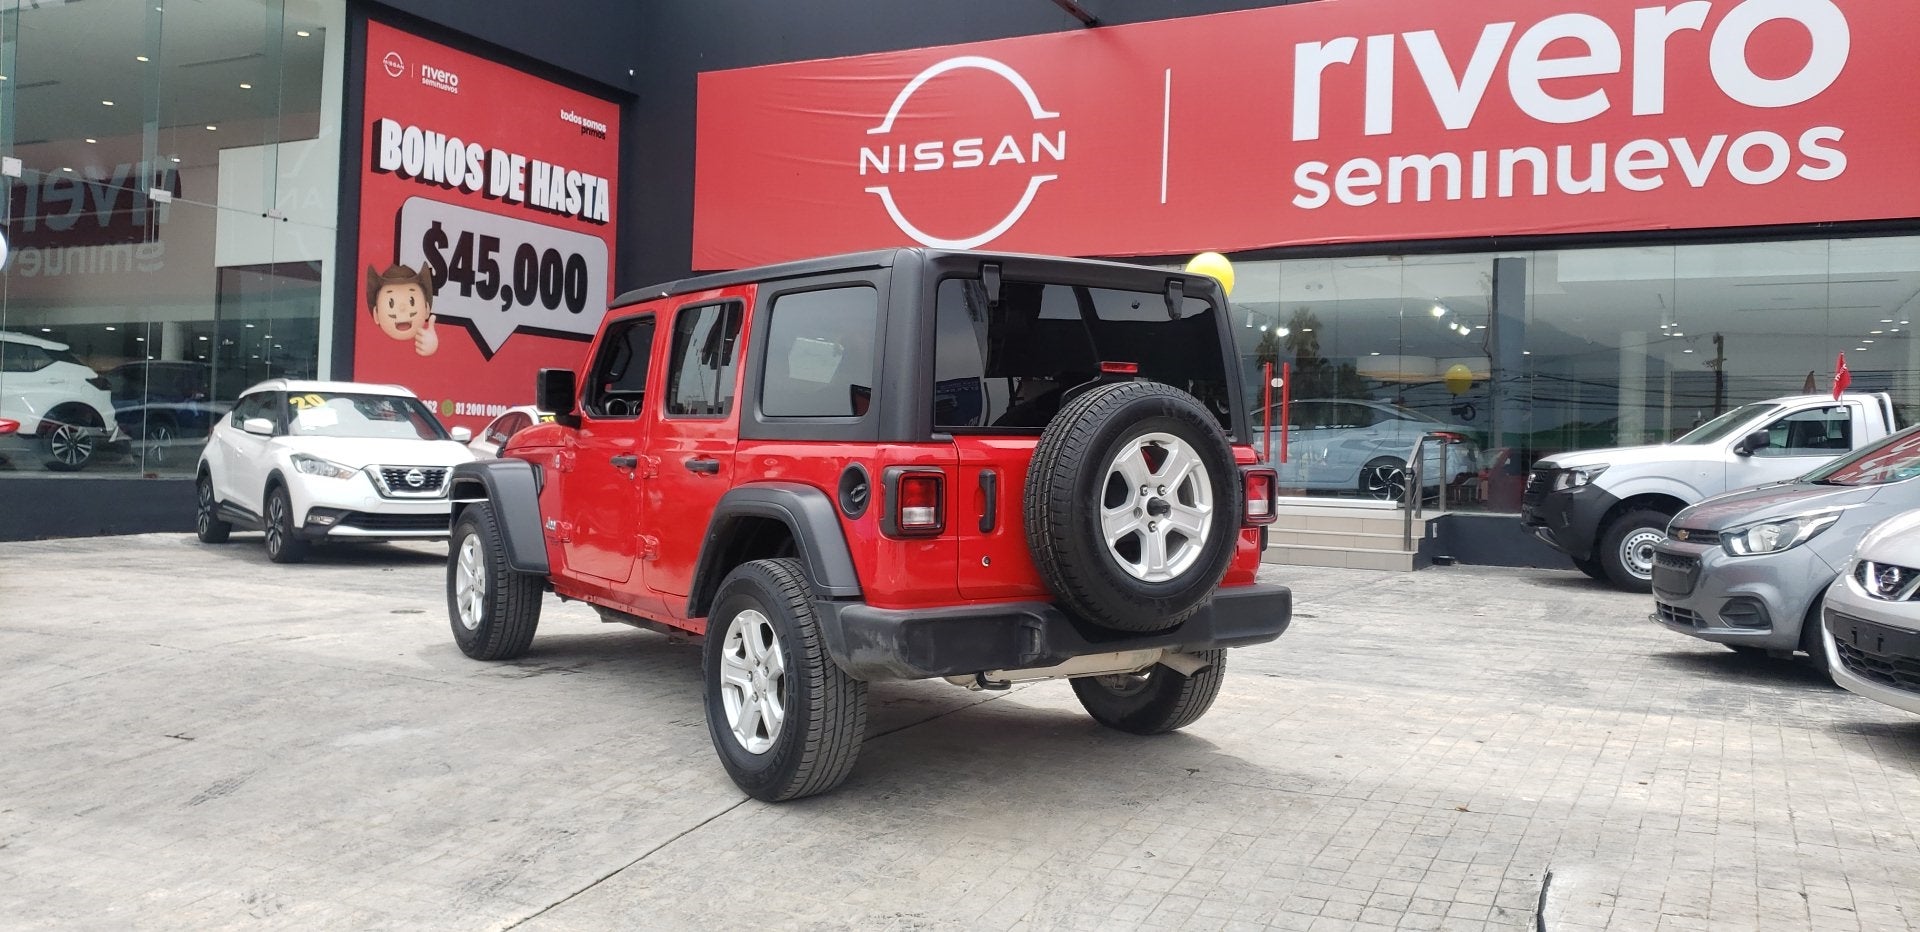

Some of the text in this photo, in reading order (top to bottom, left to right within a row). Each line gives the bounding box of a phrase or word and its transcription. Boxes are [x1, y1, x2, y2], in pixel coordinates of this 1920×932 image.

[421, 64, 459, 87] rivero
[1292, 0, 1850, 141] rivero
[421, 77, 458, 94] seminuevos
[560, 108, 607, 133] todos somos
[581, 126, 606, 140] primos
[859, 130, 1066, 176] NISSAN
[378, 118, 610, 223] BONOS DE HASTA
[1292, 126, 1848, 209] seminuevos
[422, 220, 588, 315] $45,000
[289, 394, 326, 410] 20
[455, 402, 465, 415] 81
[466, 403, 485, 417] 2001
